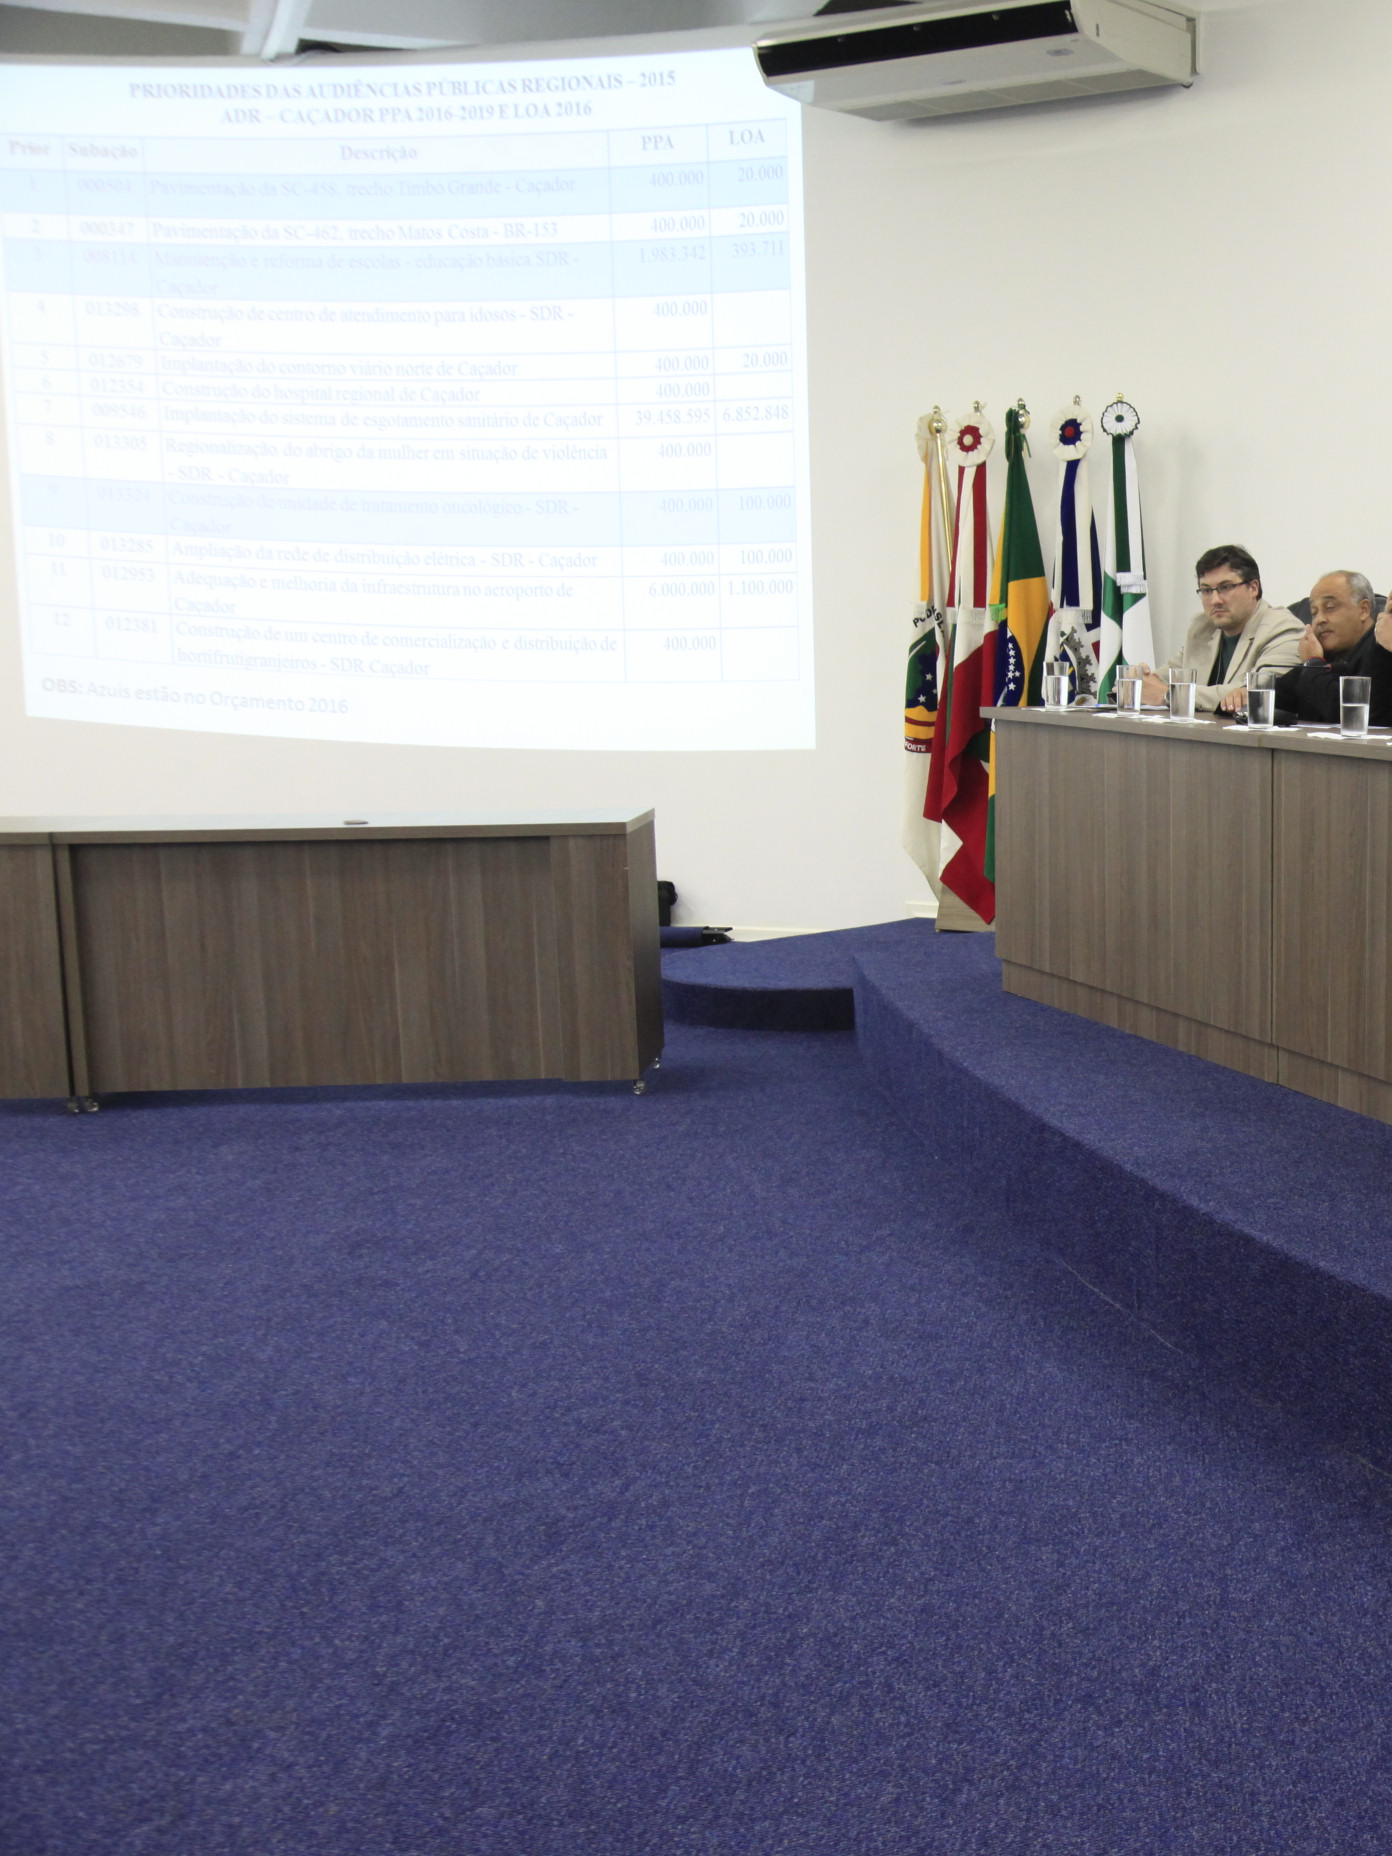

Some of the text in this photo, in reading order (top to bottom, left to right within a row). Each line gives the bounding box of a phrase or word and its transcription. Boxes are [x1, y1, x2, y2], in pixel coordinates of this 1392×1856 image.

[129, 70, 676, 99] PRIORIDADES DAS AUDIÊNCIAS PÚBLICAS REGIONAIS 2015
[220, 101, 591, 127] ADR CAÇADOR PPA 2016-2019 E LOA 2016
[42, 676, 348, 714] OBS: Azuis estão no Orçamento 2016
